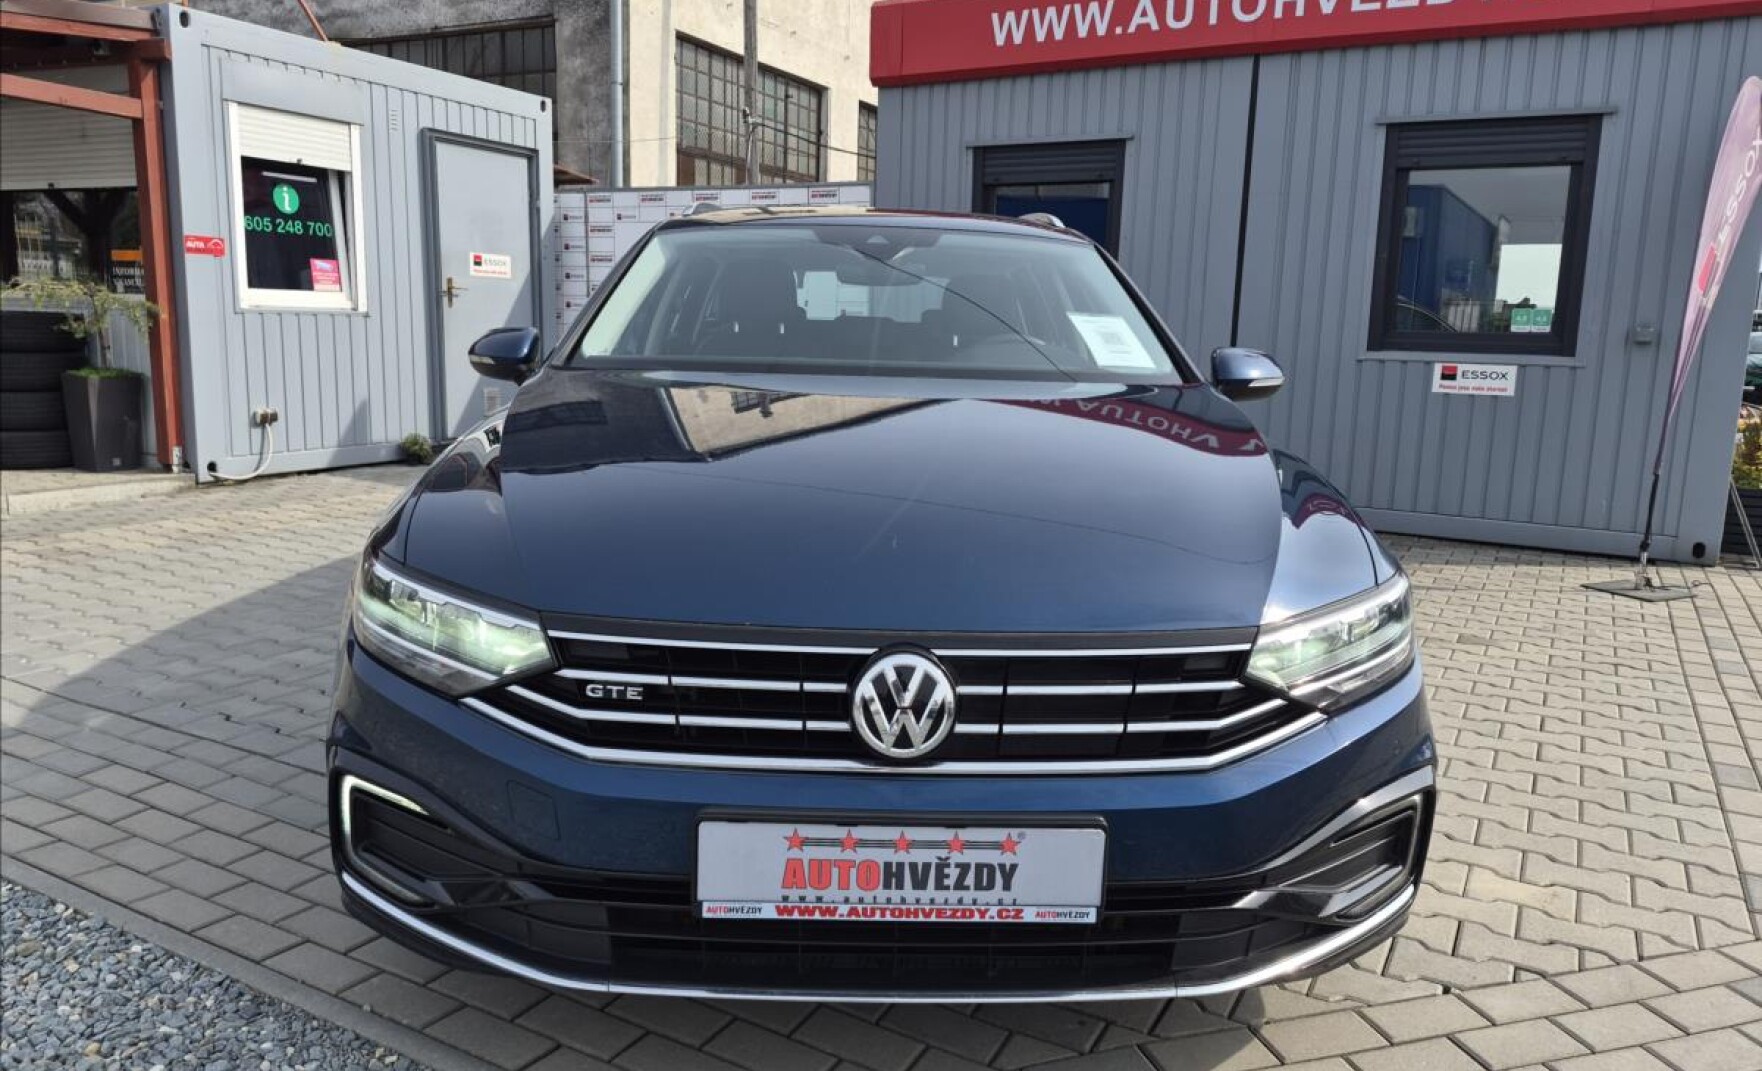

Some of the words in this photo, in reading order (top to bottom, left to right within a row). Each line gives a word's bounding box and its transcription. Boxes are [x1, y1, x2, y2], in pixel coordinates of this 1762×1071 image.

[244, 215, 272, 232] 605
[276, 218, 303, 234] 248
[307, 221, 333, 237] 700
[1461, 369, 1509, 381] ESSOX
[585, 683, 644, 700] GTE
[781, 856, 1019, 892] AUTOHVĚZDY
[775, 904, 1024, 920] WWW.AUTOHVEZDY.CZ
